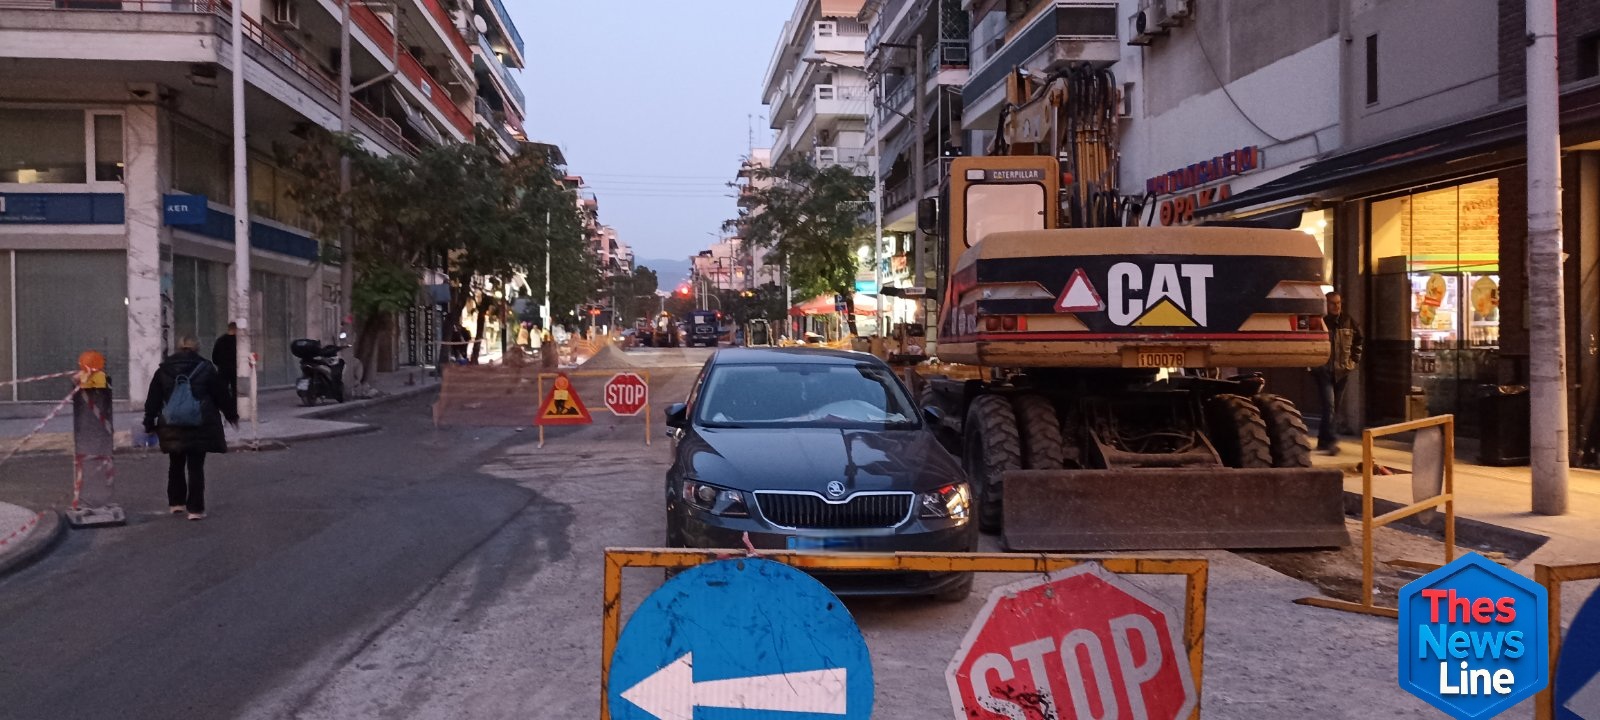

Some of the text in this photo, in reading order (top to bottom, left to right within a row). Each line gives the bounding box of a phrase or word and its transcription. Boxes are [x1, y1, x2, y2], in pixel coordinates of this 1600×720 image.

[993, 170, 1038, 179] CATERPILLAR
[1107, 261, 1214, 328] CAT
[608, 384, 645, 406] STOP
[970, 613, 1163, 720] STOP
